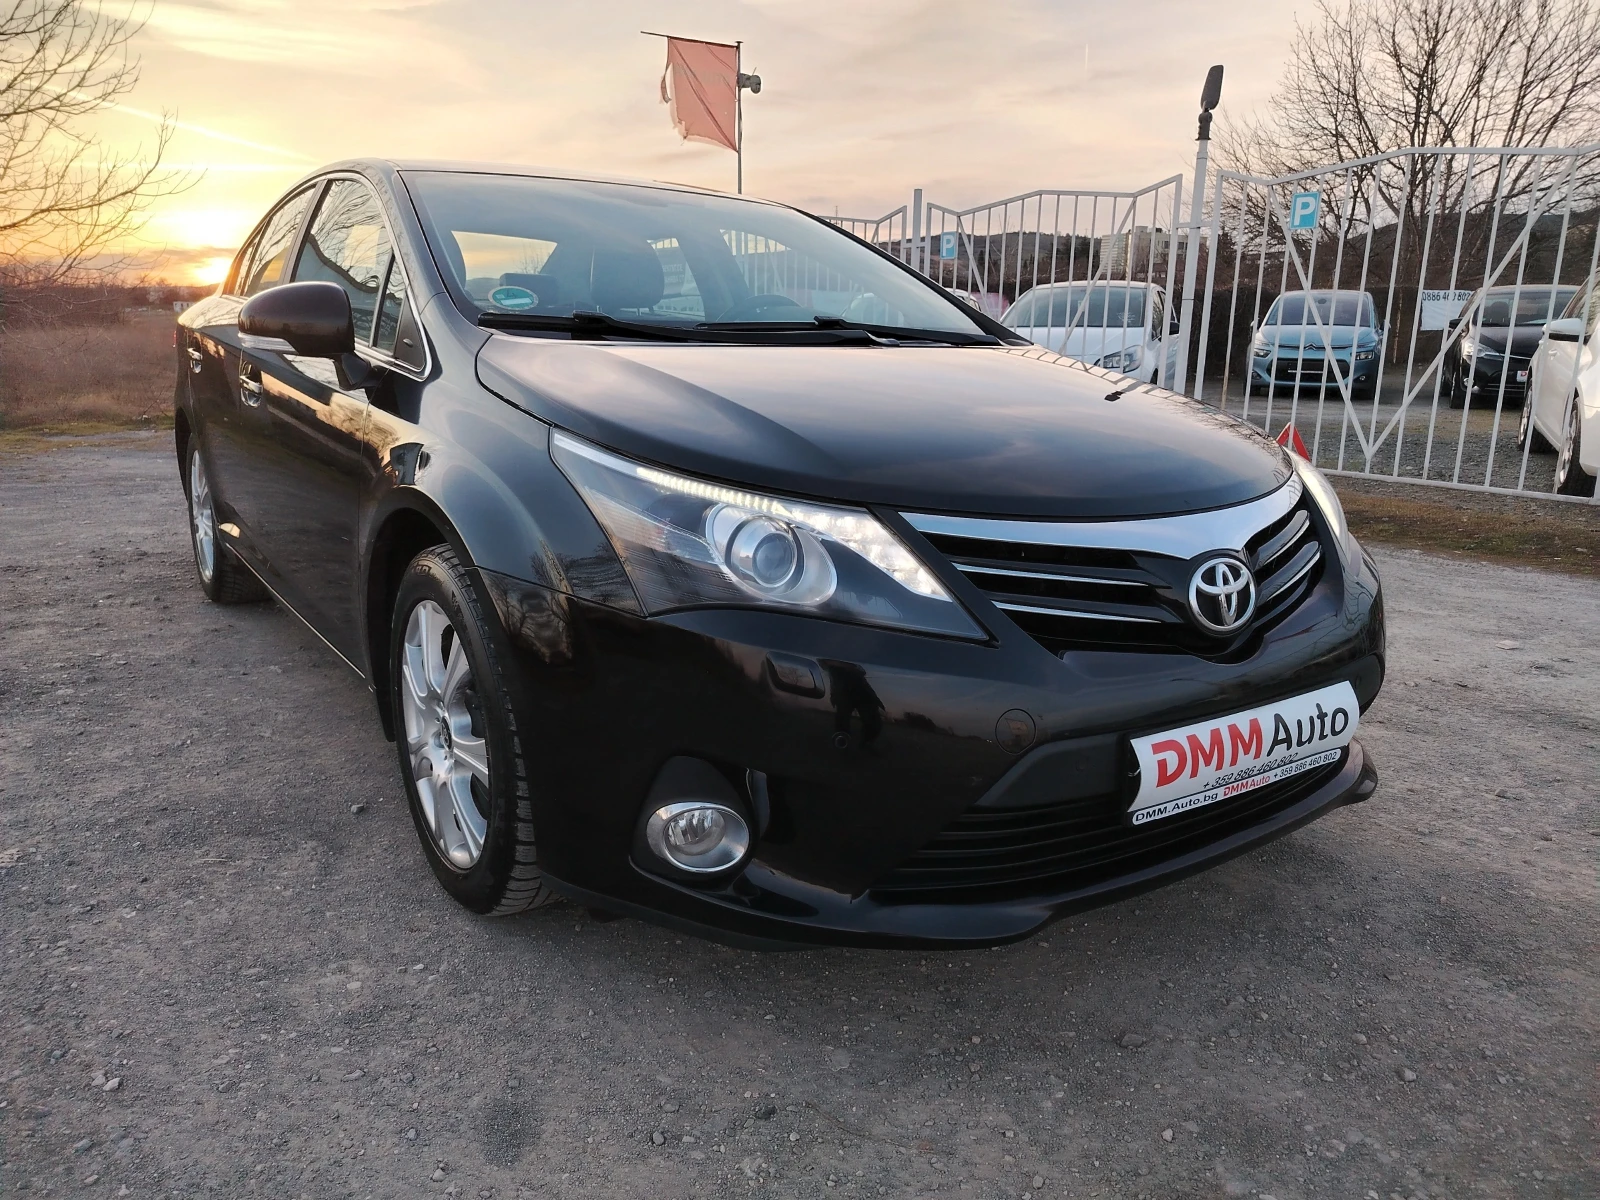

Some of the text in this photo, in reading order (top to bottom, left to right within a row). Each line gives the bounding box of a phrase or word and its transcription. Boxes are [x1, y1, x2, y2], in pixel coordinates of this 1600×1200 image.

[1293, 196, 1316, 226] P
[942, 234, 955, 257] P
[1422, 291, 1441, 301] 0886
[1212, 772, 1233, 788] 359
[1234, 766, 1256, 780] 886
[1257, 758, 1277, 772] 460
[1277, 752, 1298, 766] 802
[1279, 766, 1293, 778] 359
[1294, 762, 1308, 773] 886
[1308, 756, 1321, 768] 460
[1322, 751, 1337, 763] 802
